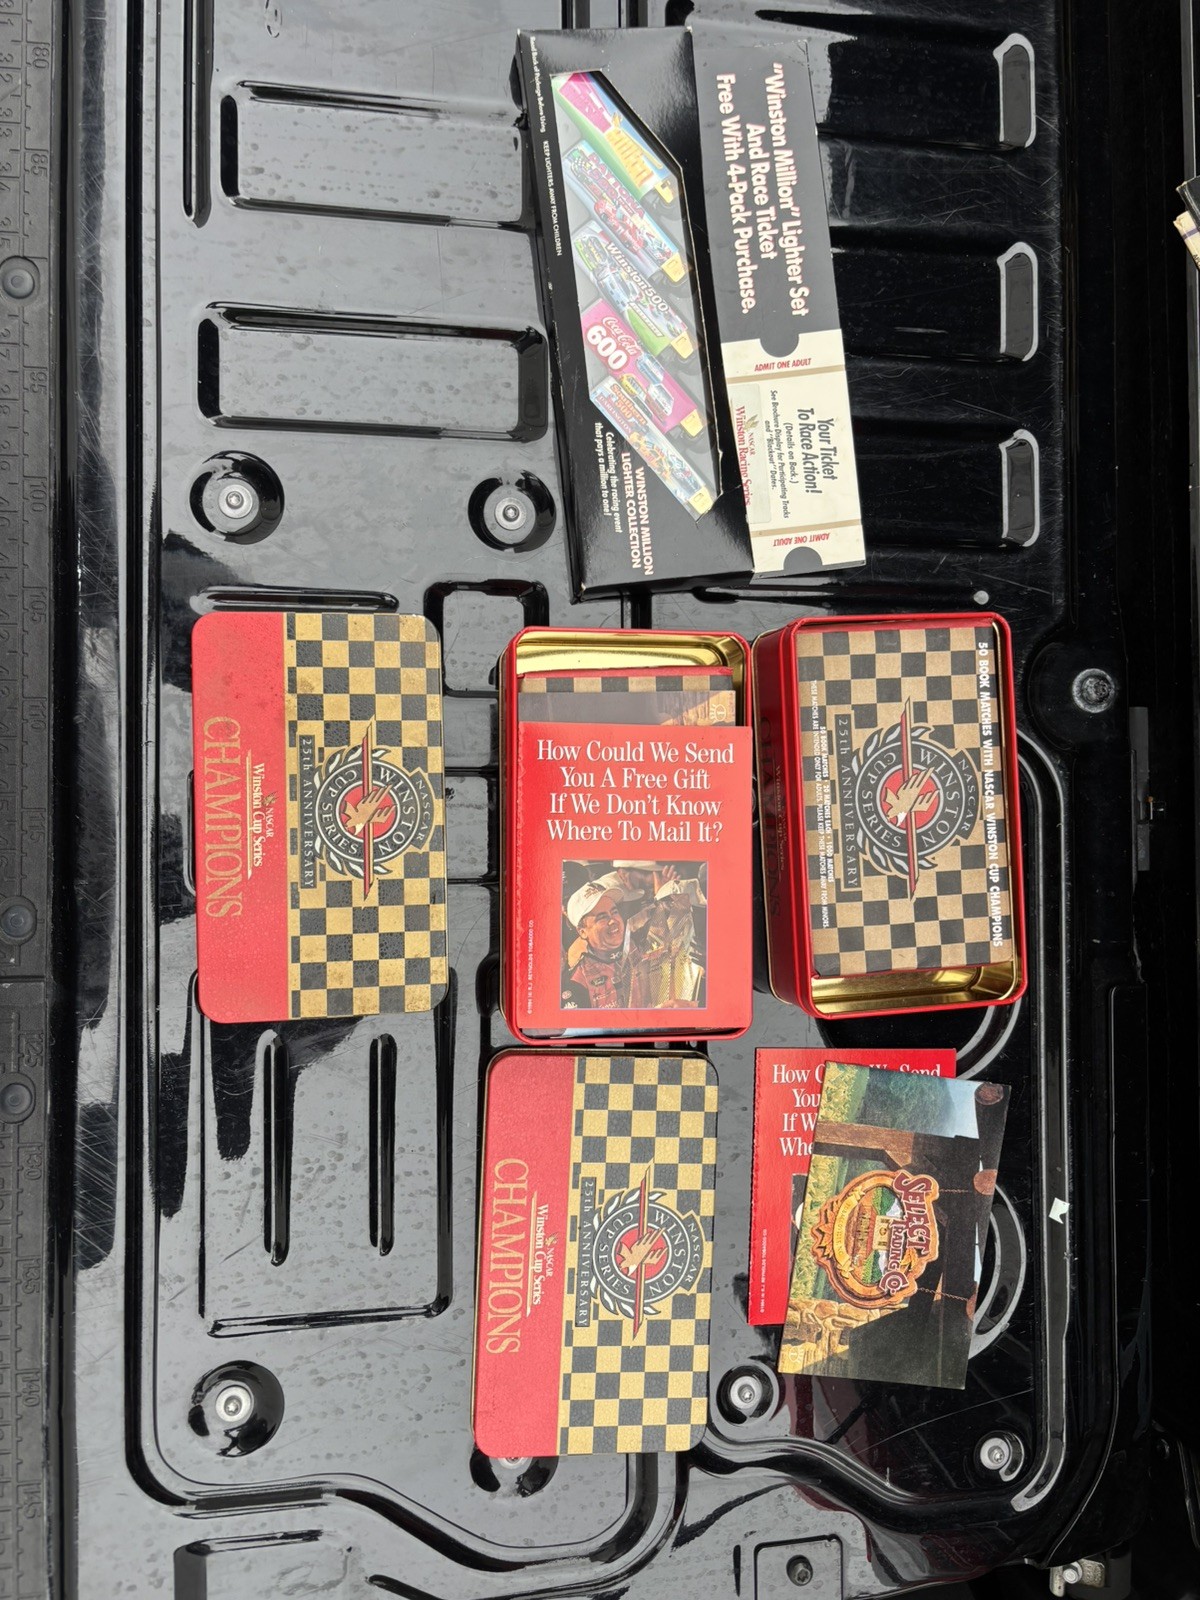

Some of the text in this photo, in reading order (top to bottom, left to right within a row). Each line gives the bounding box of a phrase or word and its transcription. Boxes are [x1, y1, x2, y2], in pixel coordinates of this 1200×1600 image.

[544, 157, 554, 186] LIGHTERS
[548, 188, 557, 204] AWAY
[717, 74, 758, 314] Free With 4-Pack Purchase.
[746, 123, 778, 259] And Race Ticket
[550, 206, 559, 223] FROM
[553, 224, 562, 256] CHILDREN
[779, 221, 805, 284] Lighter
[789, 287, 810, 316] Set
[587, 325, 628, 370] 600
[754, 358, 812, 372] ADMIT ONE ADULT
[594, 422, 603, 438] that
[610, 384, 648, 425] Southern
[615, 400, 632, 418] 500
[736, 406, 750, 446] Winston
[594, 438, 604, 456] pays
[748, 432, 756, 456] NASCAR
[764, 420, 772, 432] and
[770, 470, 778, 490] Dates.
[770, 390, 790, 518] See Brochure Display for Participating Tracks
[784, 422, 799, 484] (Details on Back.)
[798, 408, 822, 494] To Race Action!
[817, 418, 839, 480] Your Ticket
[599, 464, 608, 488] million
[606, 432, 622, 533] Celebrating the racing event
[602, 499, 611, 516] one!
[621, 452, 641, 568] LIGHTER COLLECTION
[635, 467, 653, 575] WINSTON MILLION
[773, 532, 830, 547] ADMIT ONE ADULT
[537, 740, 734, 764] How Could We Send
[560, 766, 711, 790] You A Free Gift
[203, 716, 244, 918] CHAMPIONS
[249, 763, 266, 866] Winston Cup Series
[265, 807, 274, 838] NASCAR
[302, 738, 316, 888] 25th ANNIVERSARY
[322, 770, 360, 854] CUP SERIES
[378, 766, 415, 855] WINSTON
[414, 780, 432, 842] NASCAR
[550, 793, 566, 814] If
[570, 793, 600, 814] We
[666, 796, 722, 816] Know
[838, 718, 858, 886] 25th ANNIVERSARY
[861, 752, 904, 849] CUP SERIES
[919, 747, 960, 848] WINSTON
[958, 758, 976, 832] NASCAR
[978, 642, 1002, 947] 50 BOOK MATCHES WITH NASCAR WINSTON CUP CHAMPIONS
[547, 820, 722, 842] Where To Mail It?
[772, 1064, 811, 1084] How
[792, 1089, 820, 1108] You
[783, 1114, 798, 1132] If
[888, 1218, 910, 1270] TRADING
[893, 1172, 933, 1258] SELECT
[484, 1158, 529, 1354] CHAMPIONS
[530, 1204, 548, 1306] Winston Cup Series
[546, 1247, 554, 1277] NASCAR
[577, 1180, 594, 1326] 25th ANNIVERSARY
[598, 1212, 634, 1296] CUP SERIES
[648, 1210, 686, 1297] WINSTON
[684, 1222, 700, 1283] NASCAR
